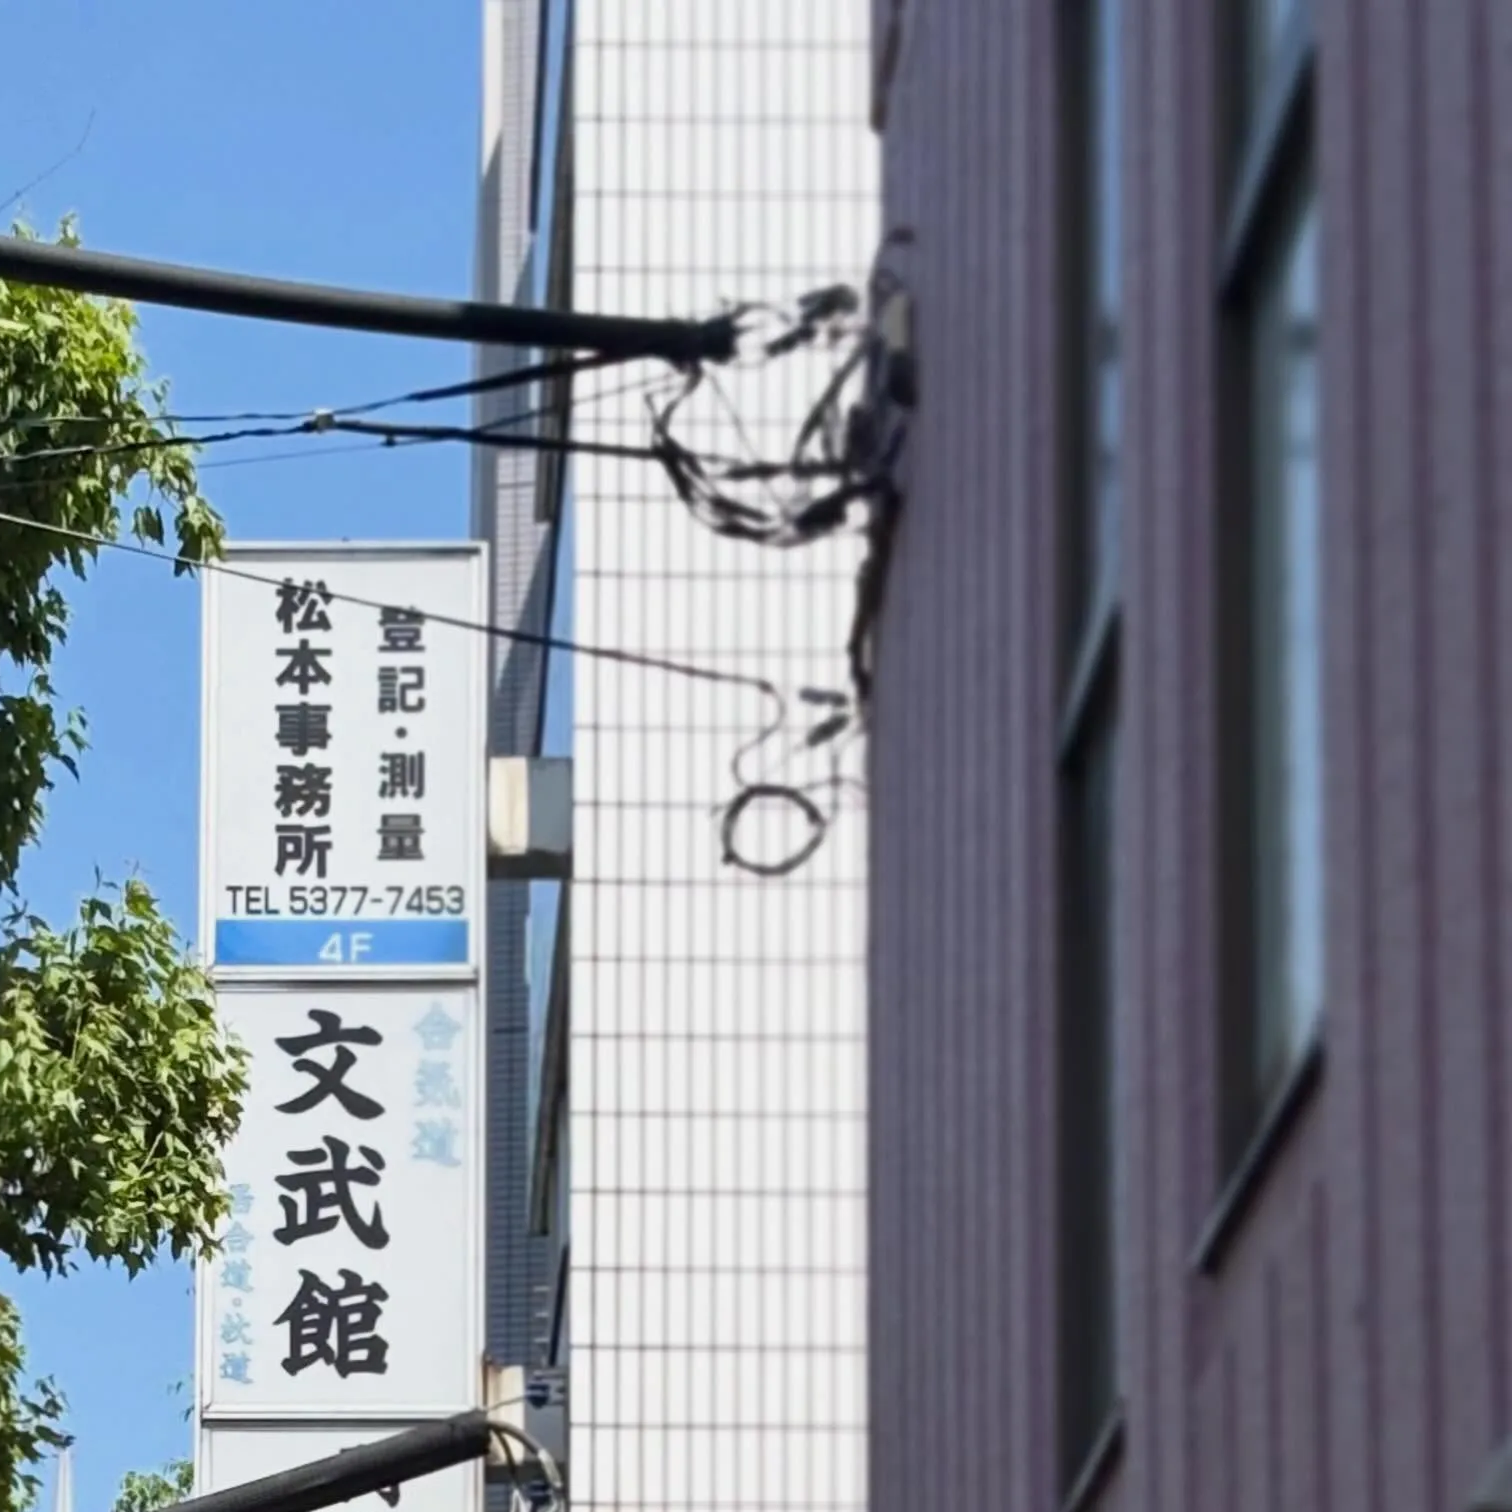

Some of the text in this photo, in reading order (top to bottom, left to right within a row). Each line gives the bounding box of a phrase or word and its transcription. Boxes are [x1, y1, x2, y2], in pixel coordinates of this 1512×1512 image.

[275, 577, 333, 878] 松本事務所
[377, 605, 426, 861] 登記・測量
[226, 885, 465, 915] TEL 5377-7453
[318, 932, 374, 963] 4F
[273, 1008, 390, 1379] 文武館
